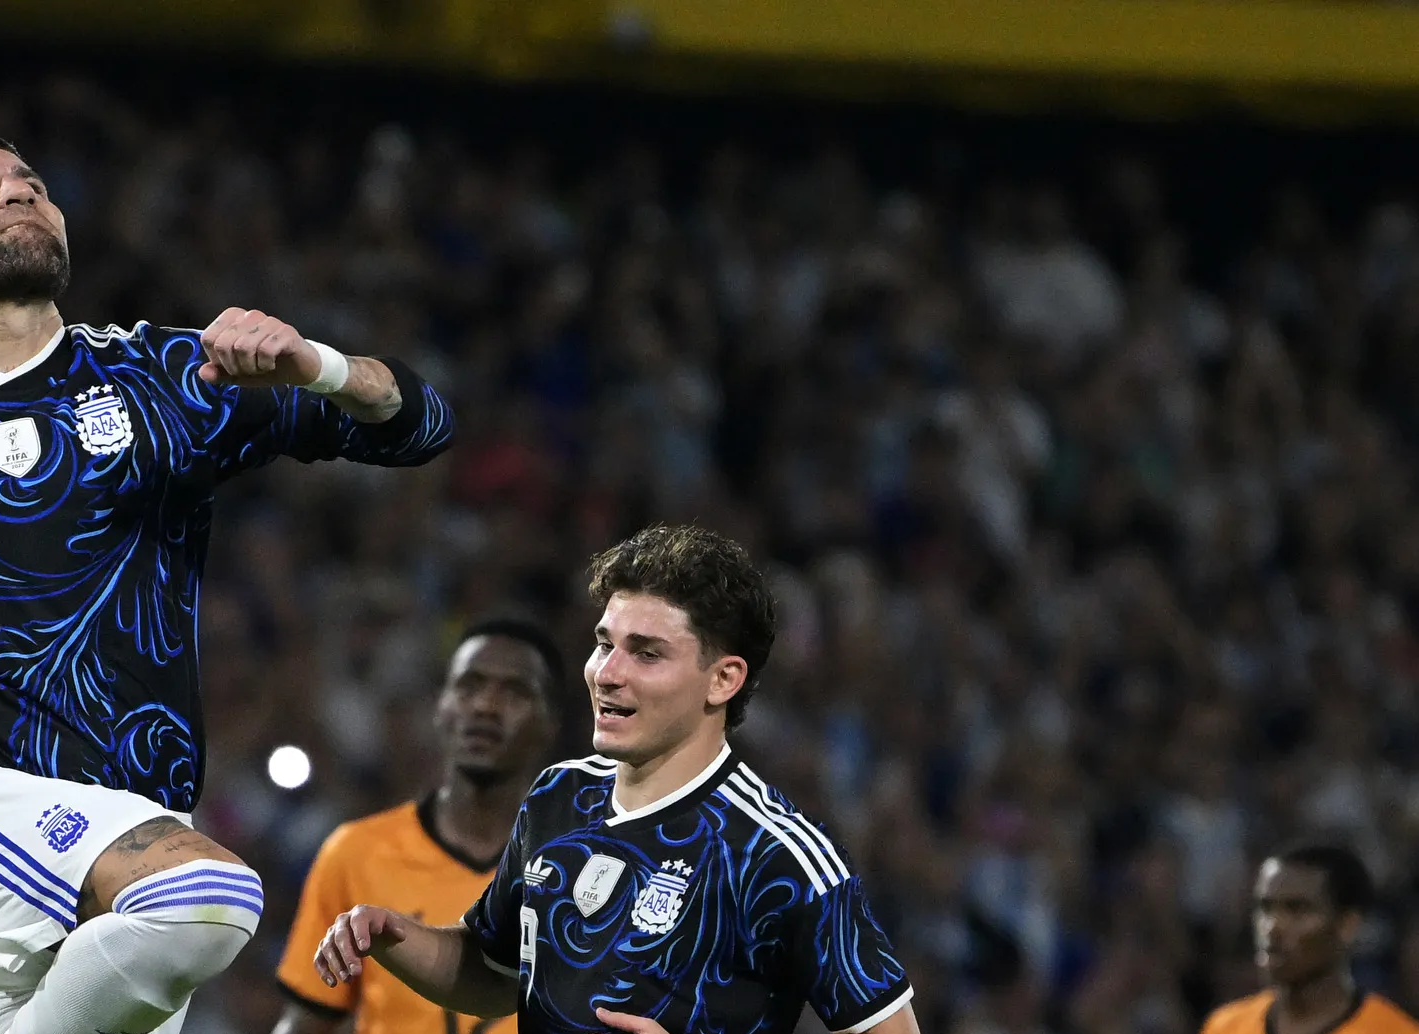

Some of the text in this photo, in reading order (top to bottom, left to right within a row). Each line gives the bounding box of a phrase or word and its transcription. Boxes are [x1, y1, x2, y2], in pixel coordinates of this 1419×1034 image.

[90, 411, 121, 436] AFA
[5, 452, 28, 462] FIFA
[582, 891, 599, 901] FIFA
[643, 887, 671, 916] AFA
